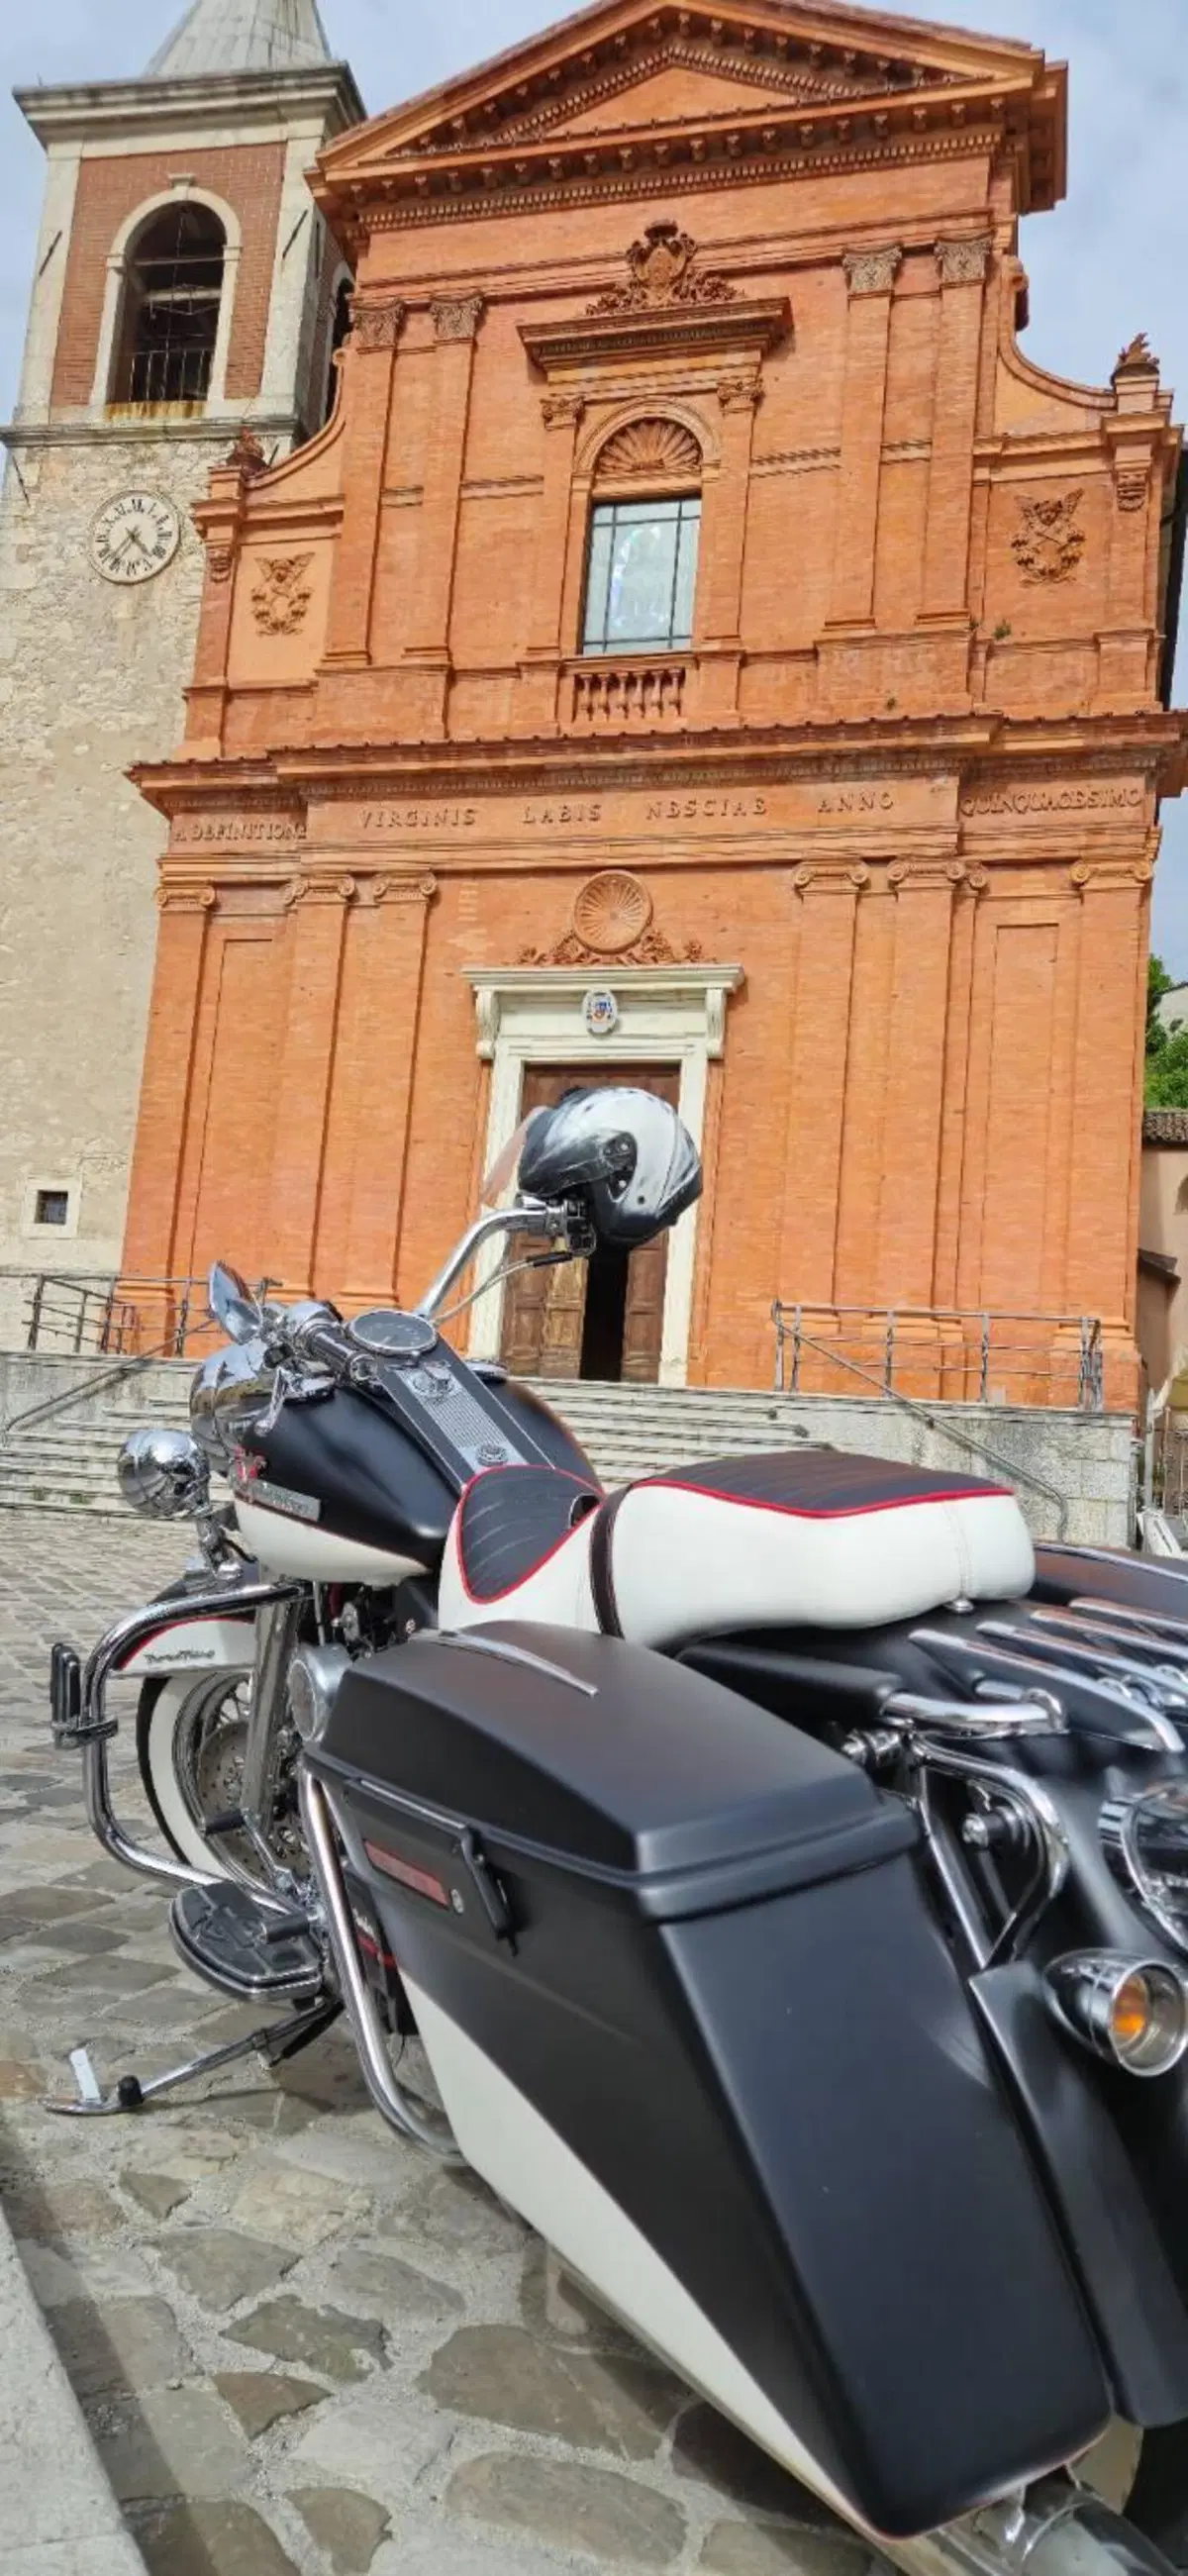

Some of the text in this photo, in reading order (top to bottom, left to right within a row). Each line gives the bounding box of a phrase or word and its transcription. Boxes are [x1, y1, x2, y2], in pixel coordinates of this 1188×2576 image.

[361, 807, 477, 829] VIRGINIS
[521, 803, 602, 825] LABIS
[645, 797, 767, 821] NESCIAE
[818, 791, 895, 813] ANNO
